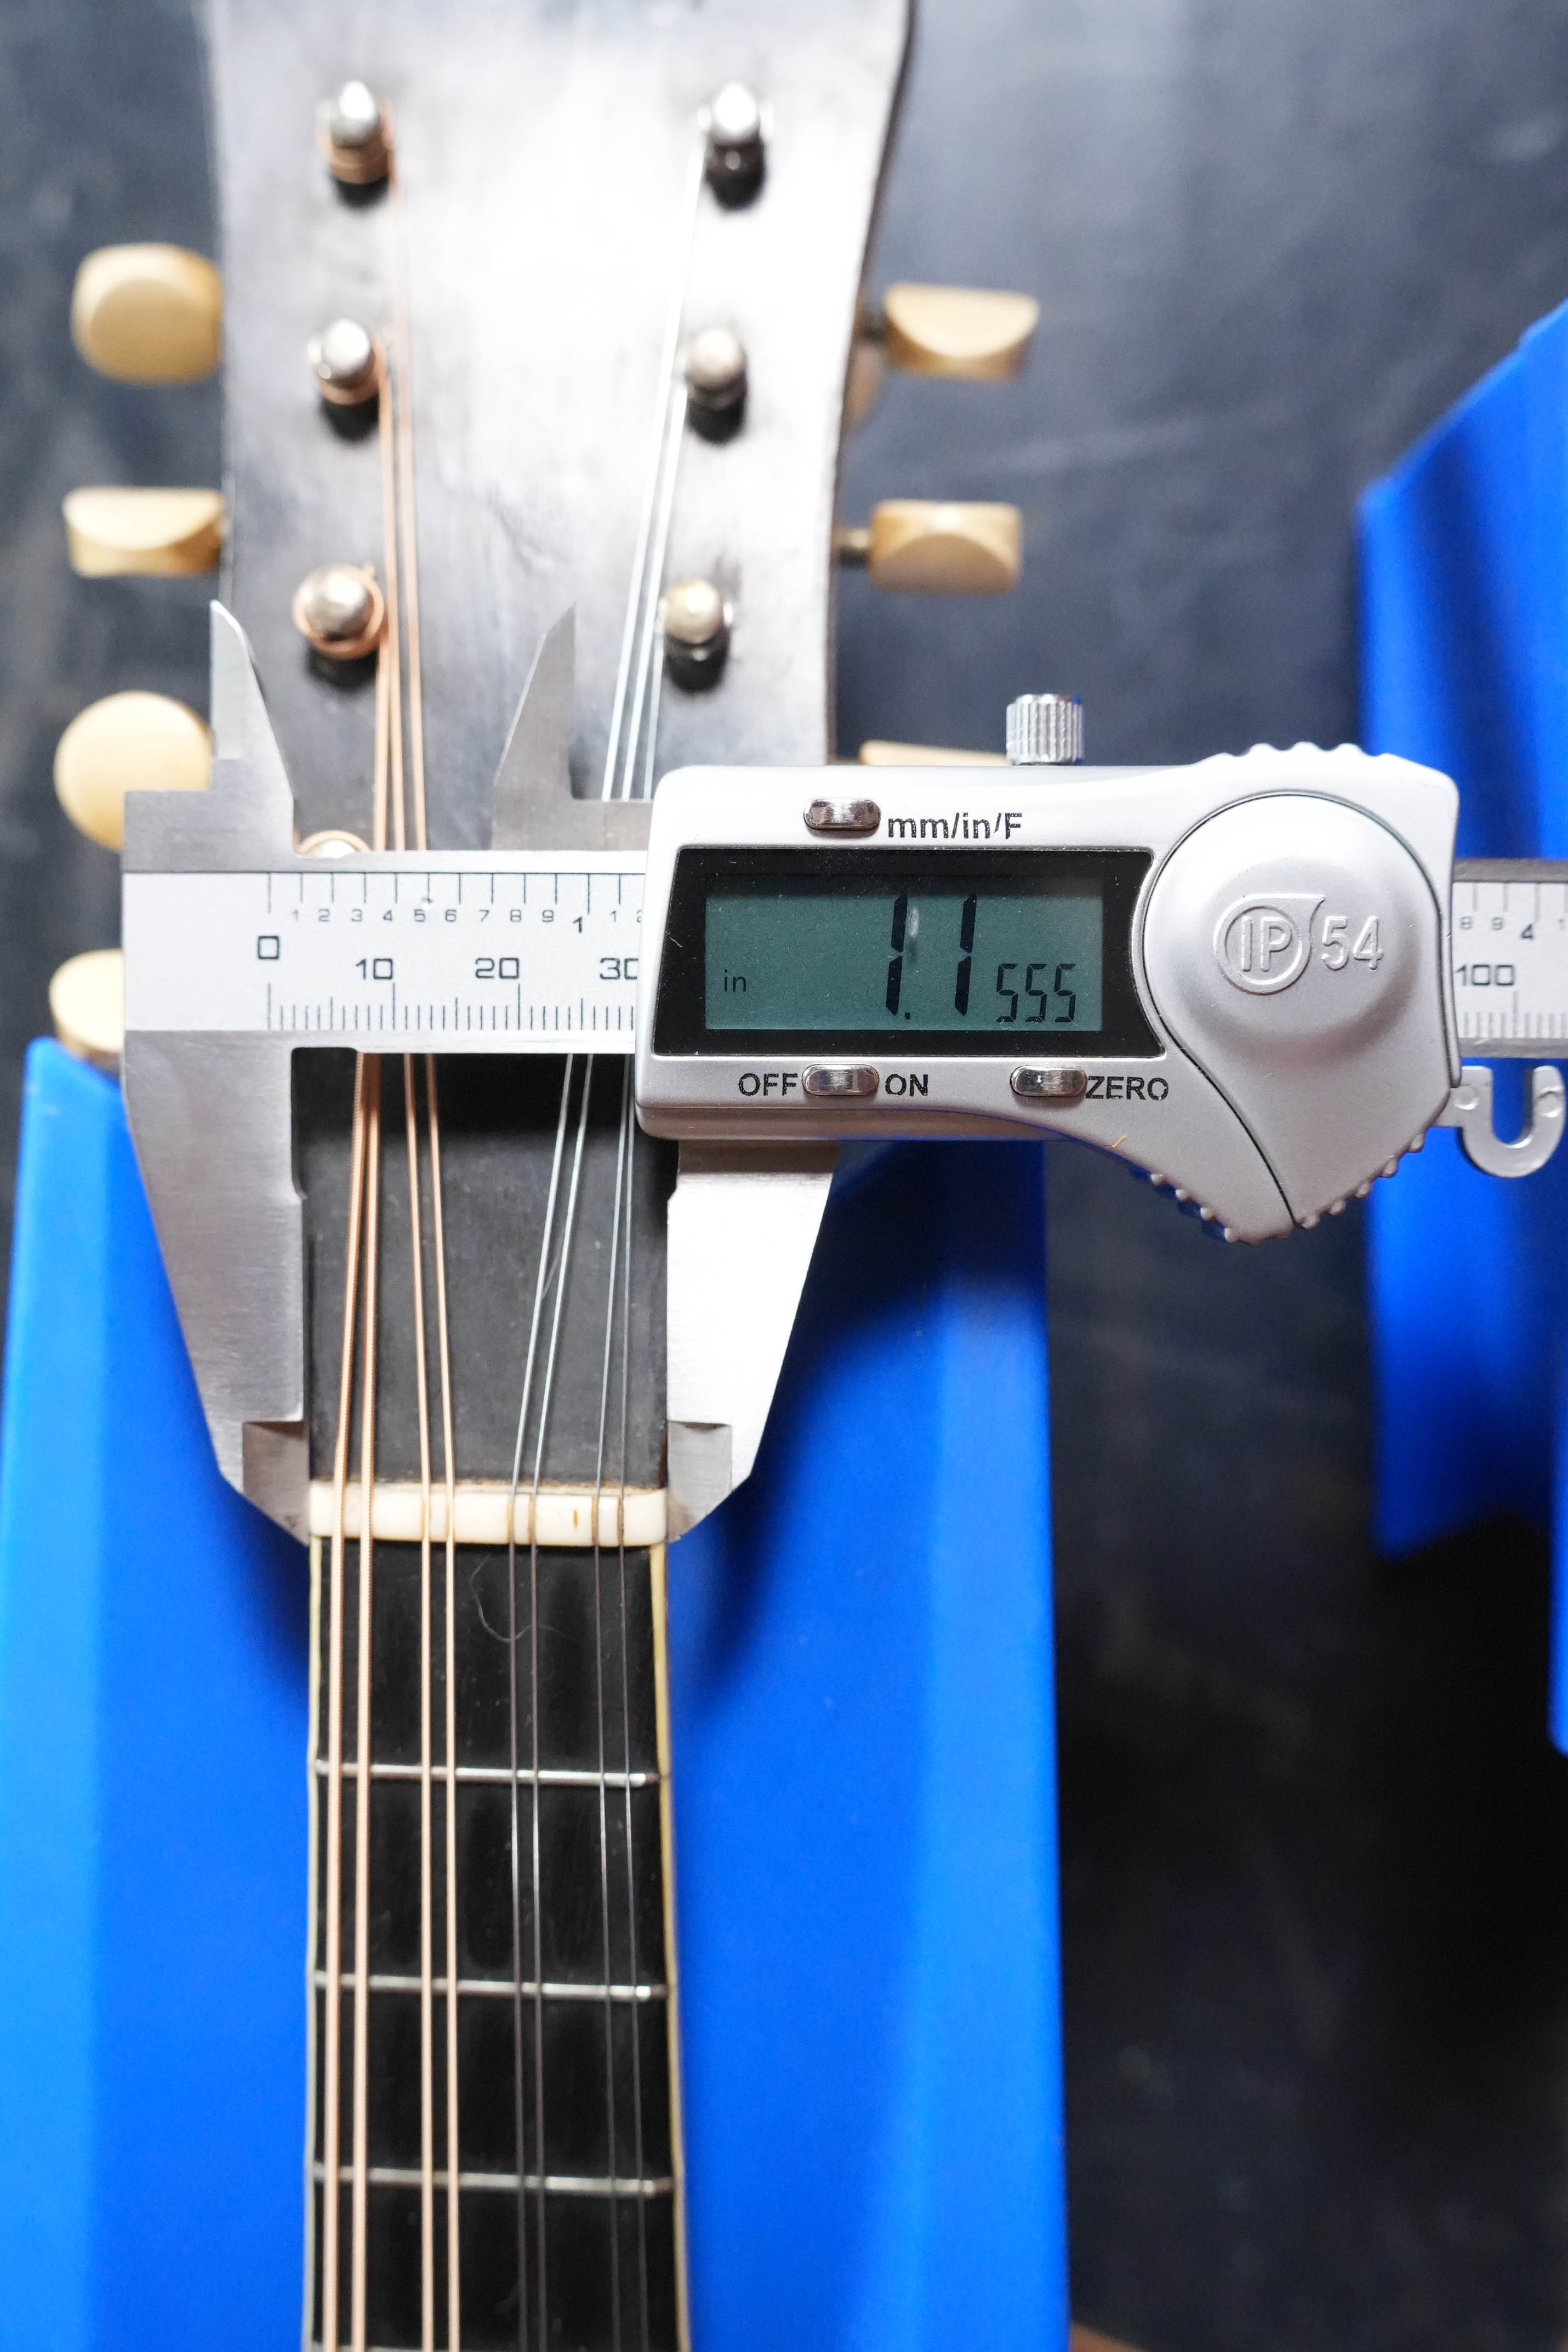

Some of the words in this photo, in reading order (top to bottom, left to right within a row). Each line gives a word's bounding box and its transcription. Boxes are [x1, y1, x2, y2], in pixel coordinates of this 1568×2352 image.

[887, 812, 1023, 840] mm/in/F
[291, 909, 300, 922] 1
[318, 908, 330, 923] 2
[351, 908, 363, 922] 3
[383, 909, 394, 922] 4
[414, 909, 426, 923] 5
[444, 909, 457, 922] 6
[478, 909, 490, 922] 7
[510, 909, 522, 922] 8
[541, 909, 555, 923] 9
[573, 916, 583, 933] 1
[610, 910, 617, 922] 1
[1459, 916, 1473, 930] 8
[1520, 923, 1535, 941] 4
[1240, 916, 1294, 973] IP
[1320, 915, 1384, 972] 54
[256, 935, 281, 961] 0
[355, 958, 394, 980] 10
[475, 957, 520, 980] 20
[723, 969, 747, 993] in
[1456, 964, 1515, 987] 100
[738, 1072, 798, 1097] OFF
[885, 1073, 929, 1097] ON
[1085, 1075, 1169, 1101] ZERO
